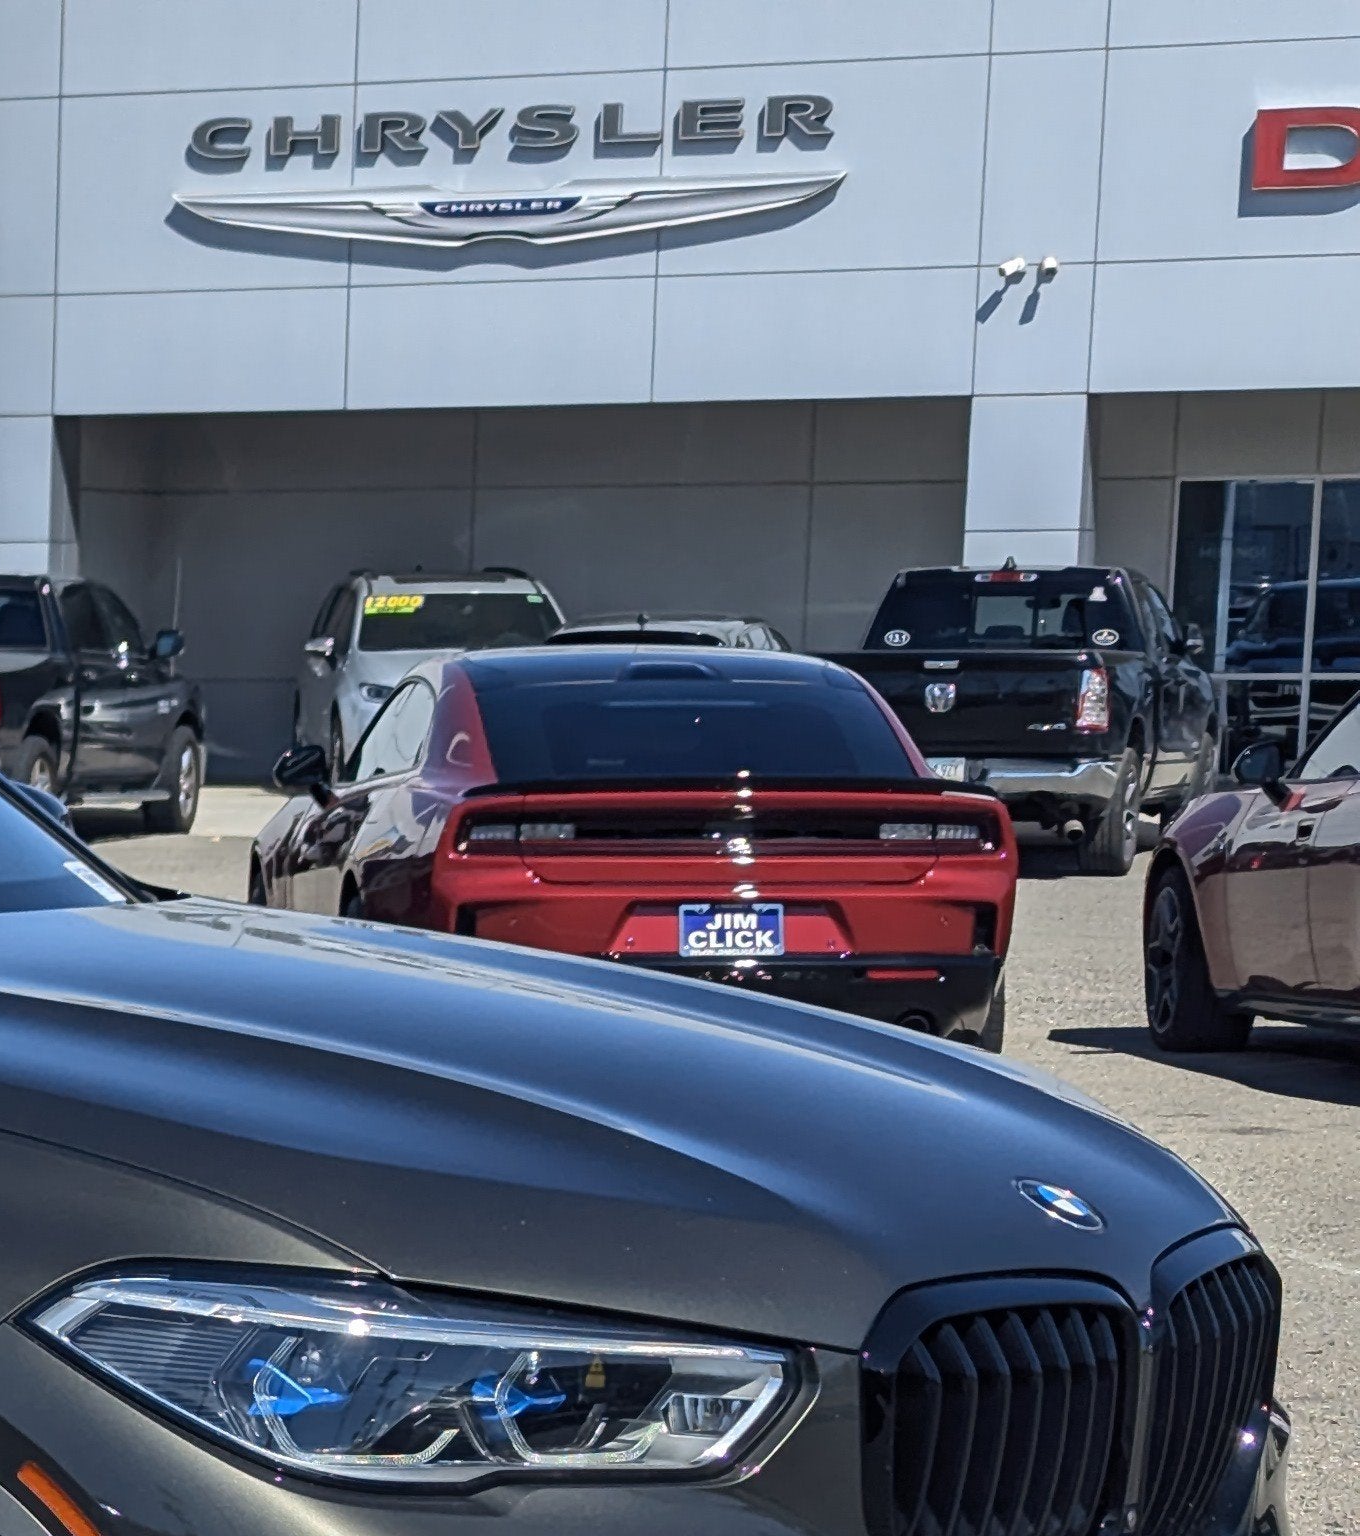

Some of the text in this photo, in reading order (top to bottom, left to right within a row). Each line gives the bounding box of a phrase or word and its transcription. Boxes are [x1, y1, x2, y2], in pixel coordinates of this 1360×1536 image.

[189, 95, 835, 158] CHRYSLER
[434, 200, 563, 213] CHRYSLER
[705, 913, 758, 930] JIM
[688, 930, 775, 949] CLICK
